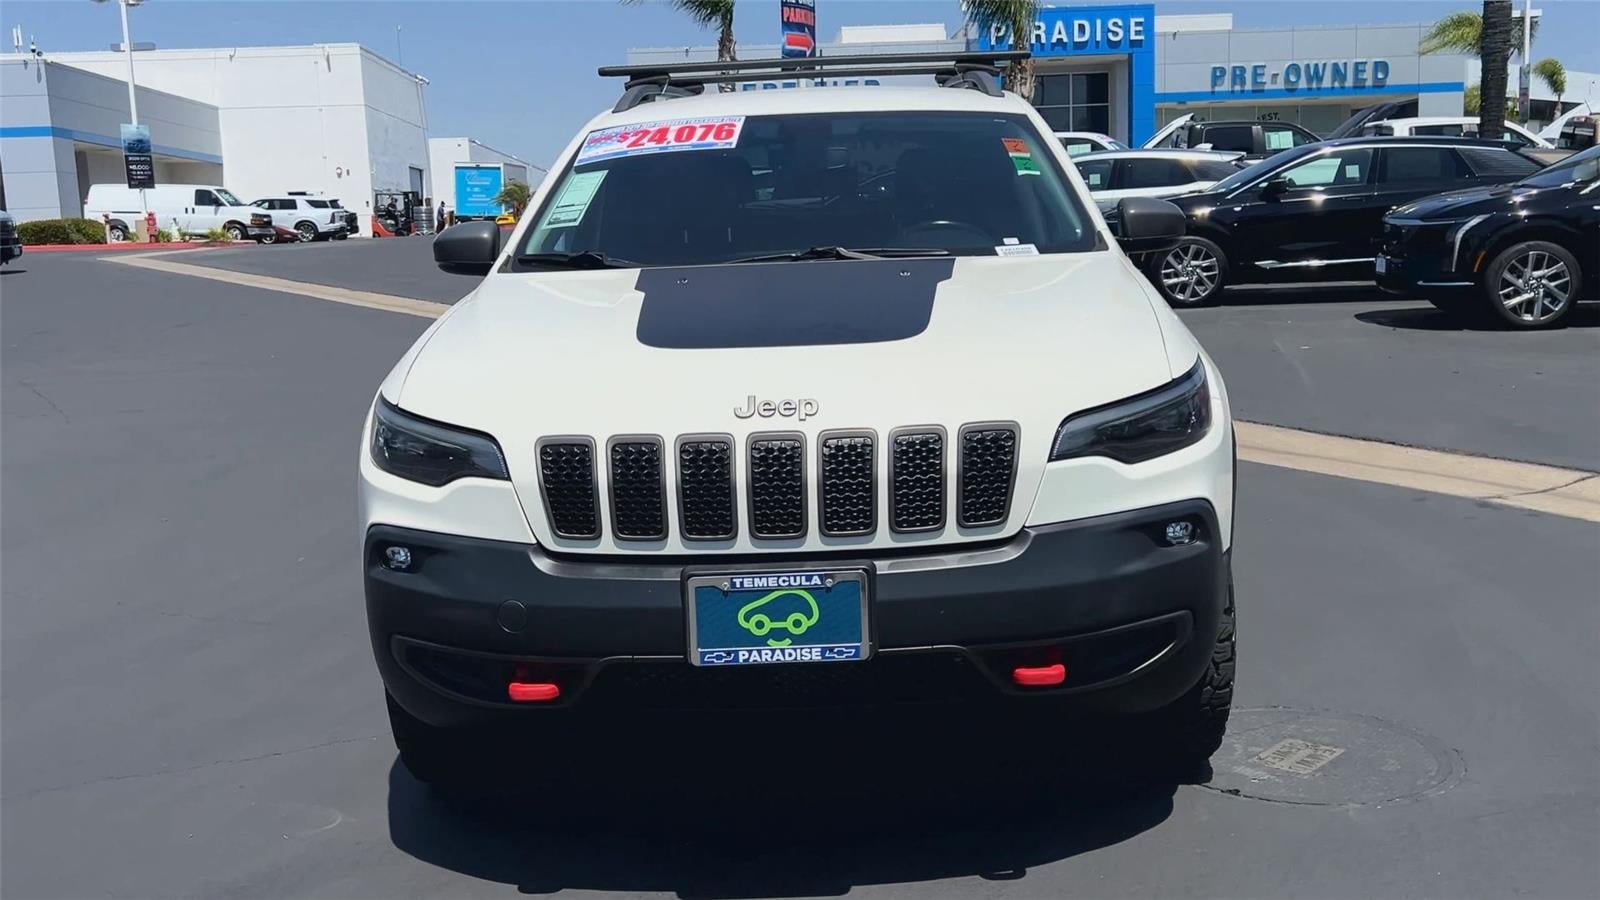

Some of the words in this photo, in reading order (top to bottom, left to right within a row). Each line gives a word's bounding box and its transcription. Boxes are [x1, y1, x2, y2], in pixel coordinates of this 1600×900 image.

[1210, 60, 1390, 90] PRE-OWNED
[618, 122, 737, 149] $24,076
[733, 394, 819, 422] Jeep
[732, 575, 822, 588] TEMECULA
[738, 647, 822, 663] PARADISE
